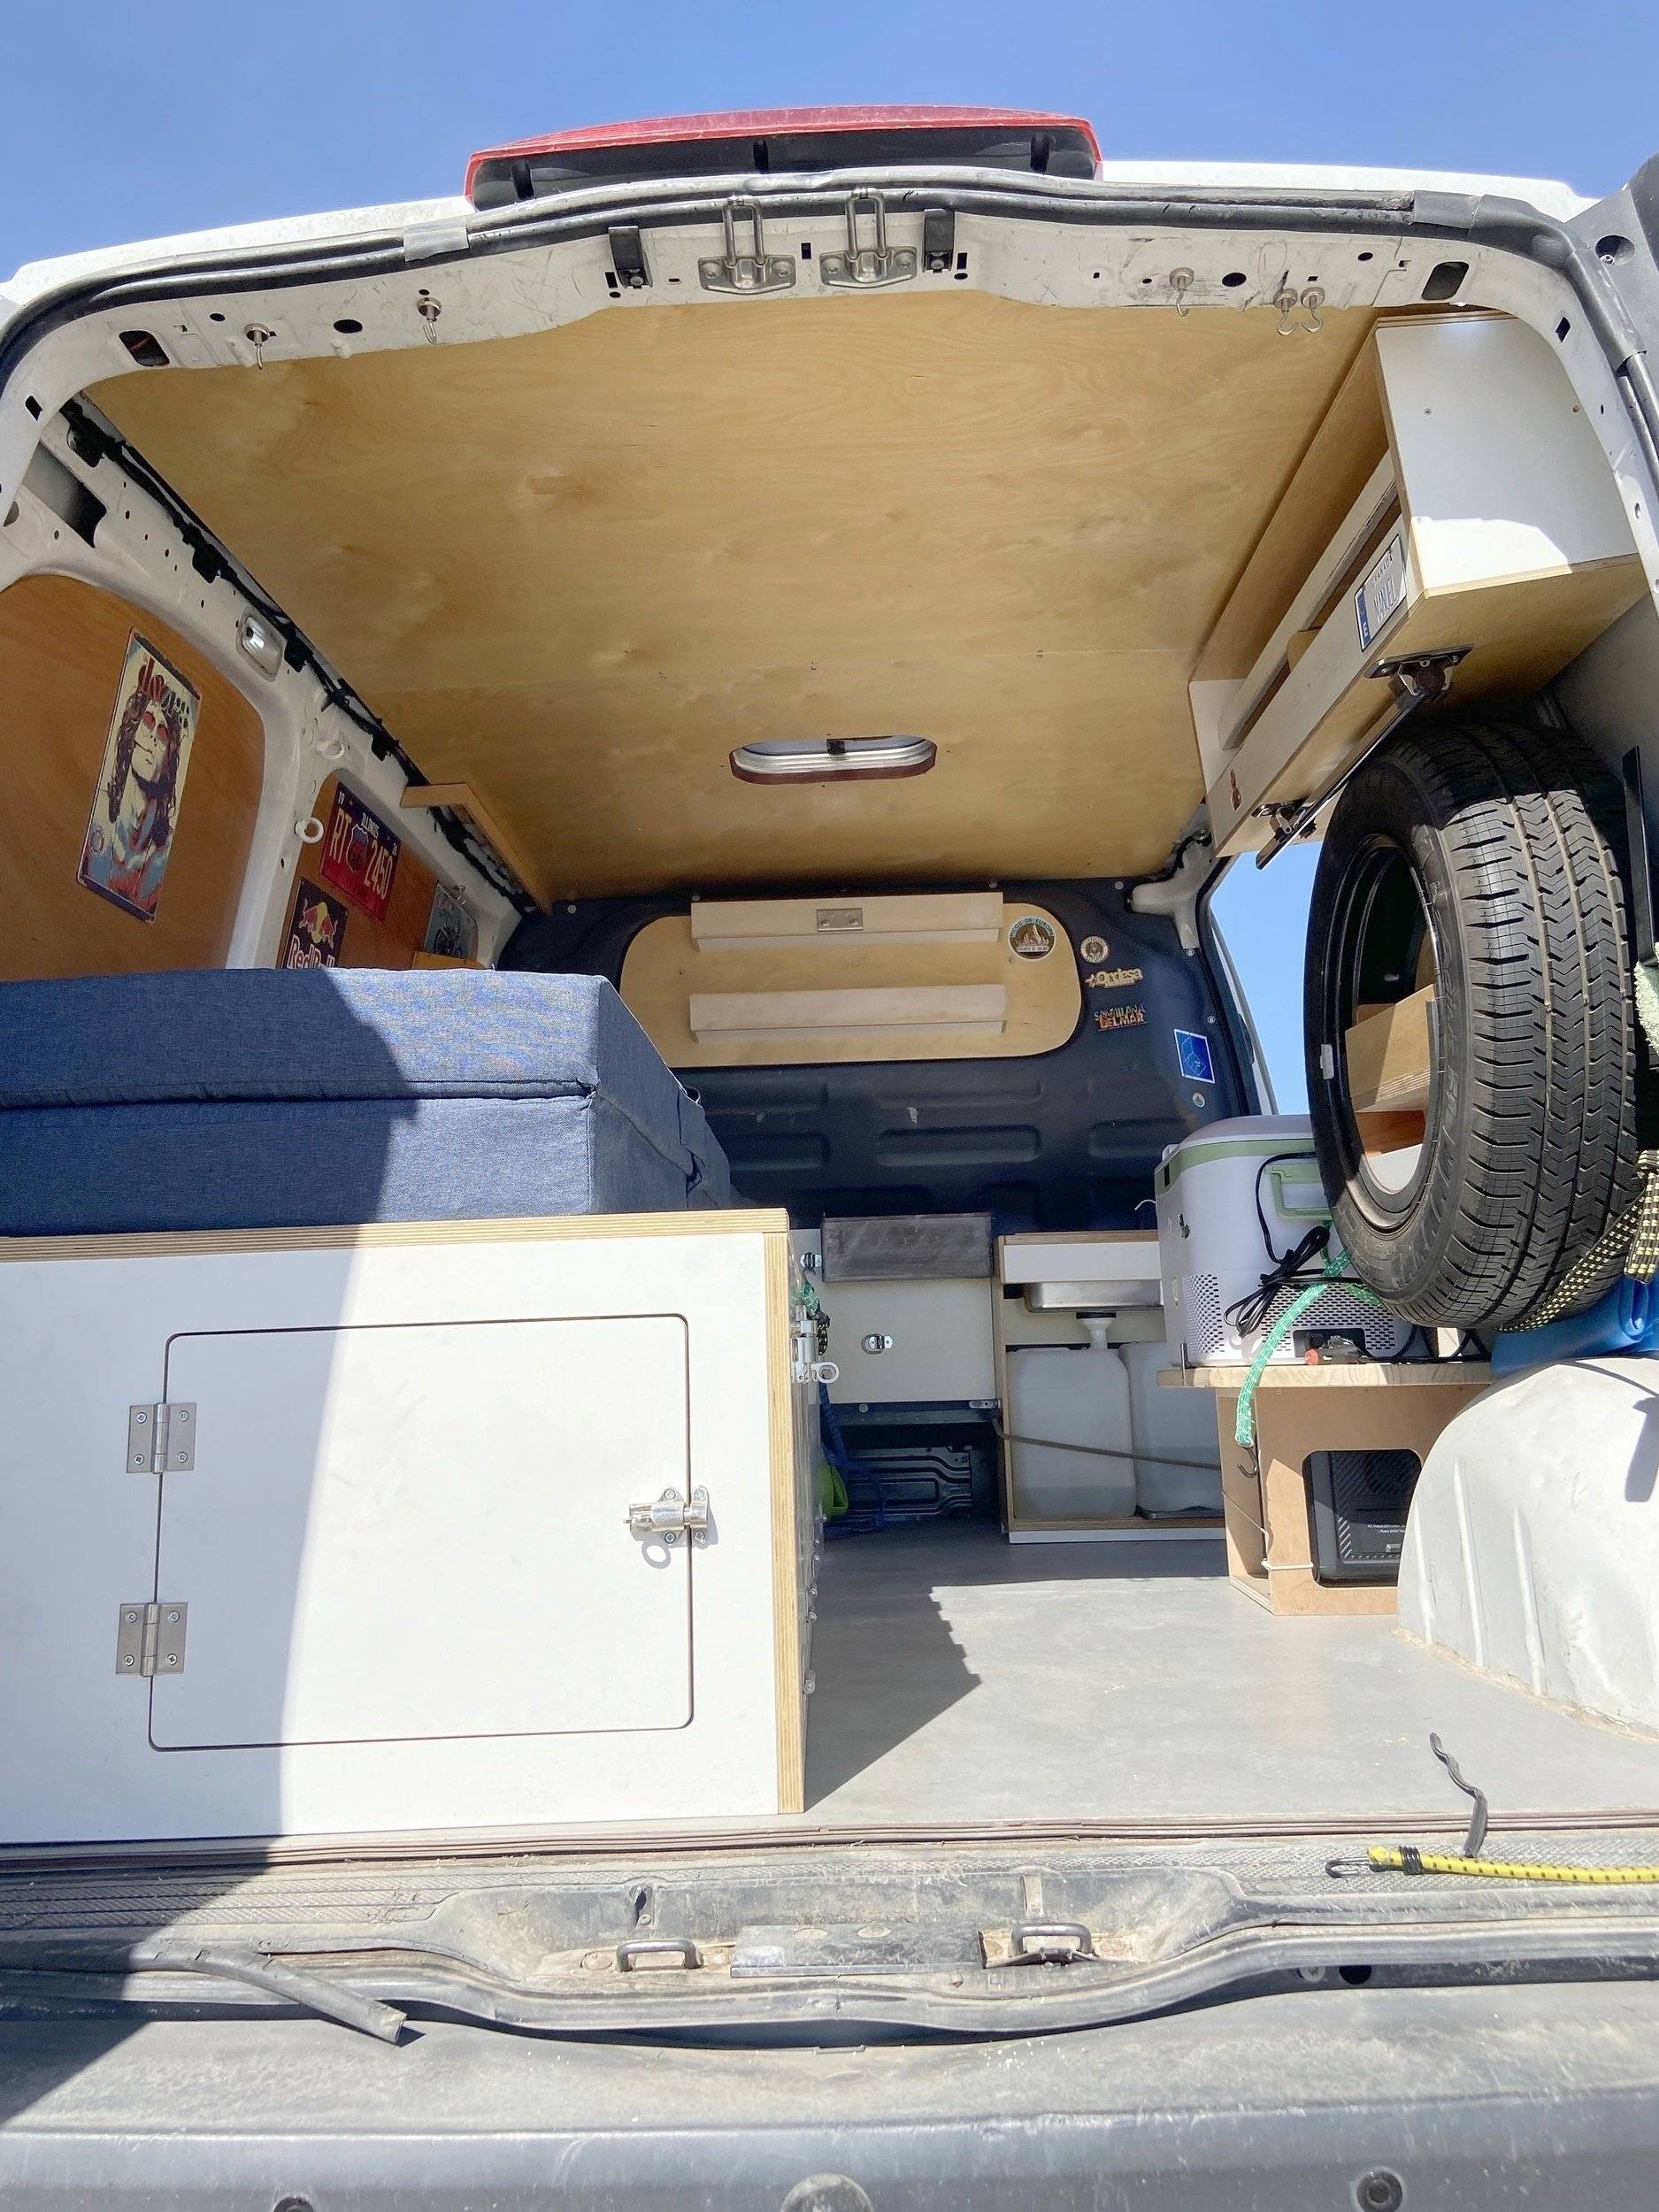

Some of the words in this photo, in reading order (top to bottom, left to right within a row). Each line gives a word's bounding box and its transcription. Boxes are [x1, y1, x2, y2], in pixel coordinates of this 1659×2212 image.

[329, 808, 352, 864] RT
[364, 839, 393, 901] 2450
[1010, 921, 1023, 937] PICOS
